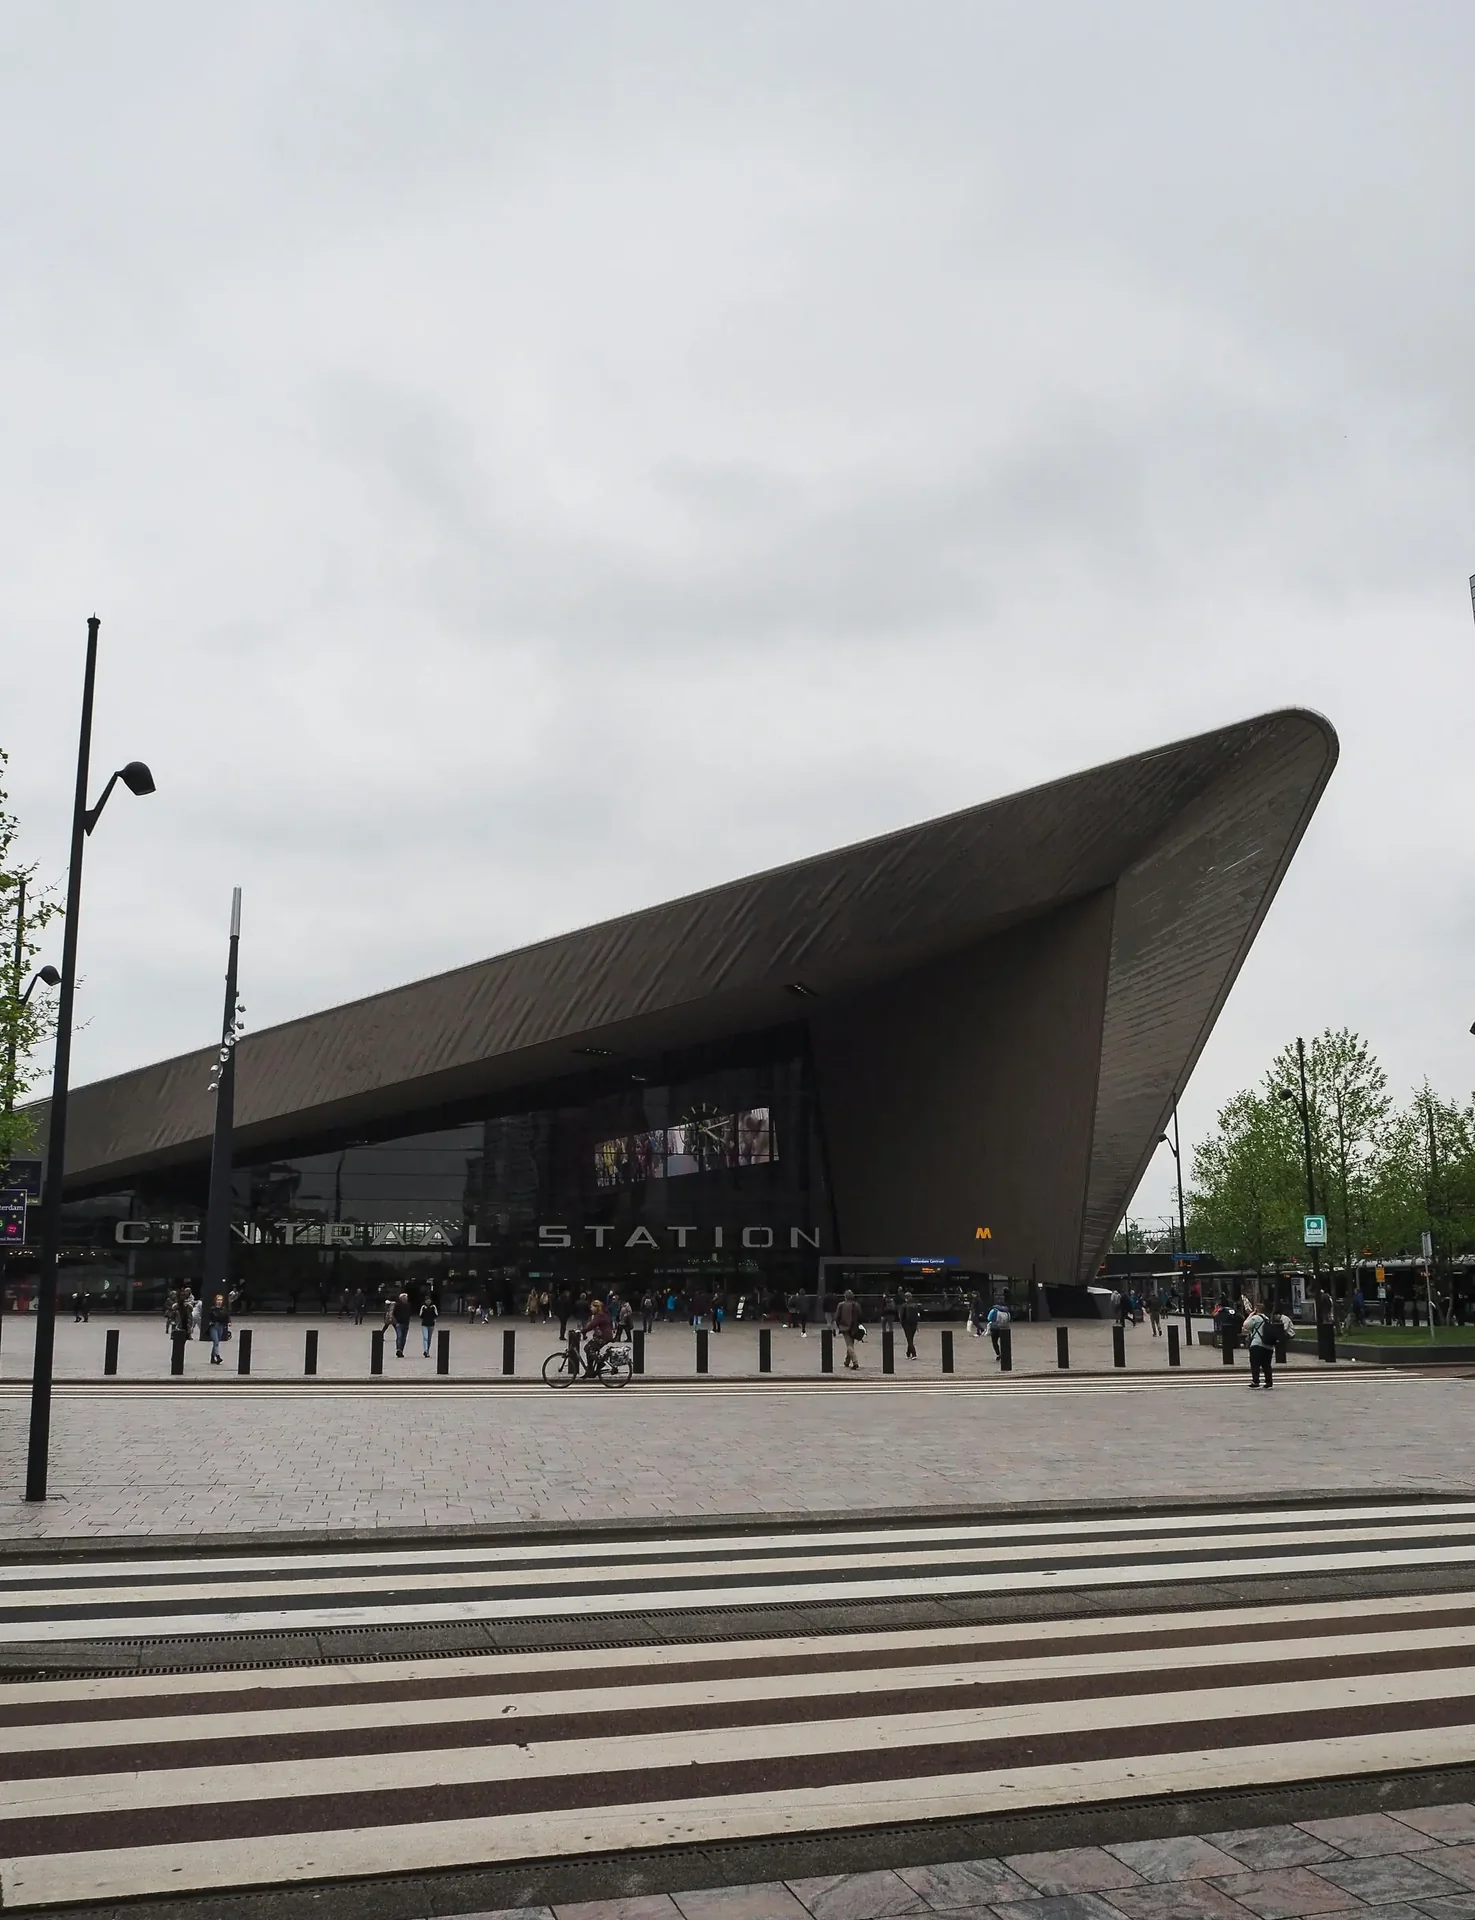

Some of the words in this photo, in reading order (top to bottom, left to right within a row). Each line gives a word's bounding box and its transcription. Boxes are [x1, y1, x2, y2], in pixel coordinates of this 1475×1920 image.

[115, 1221, 491, 1248] CENTRAAL
[538, 1225, 821, 1249] STATION
[975, 1227, 992, 1239] M
